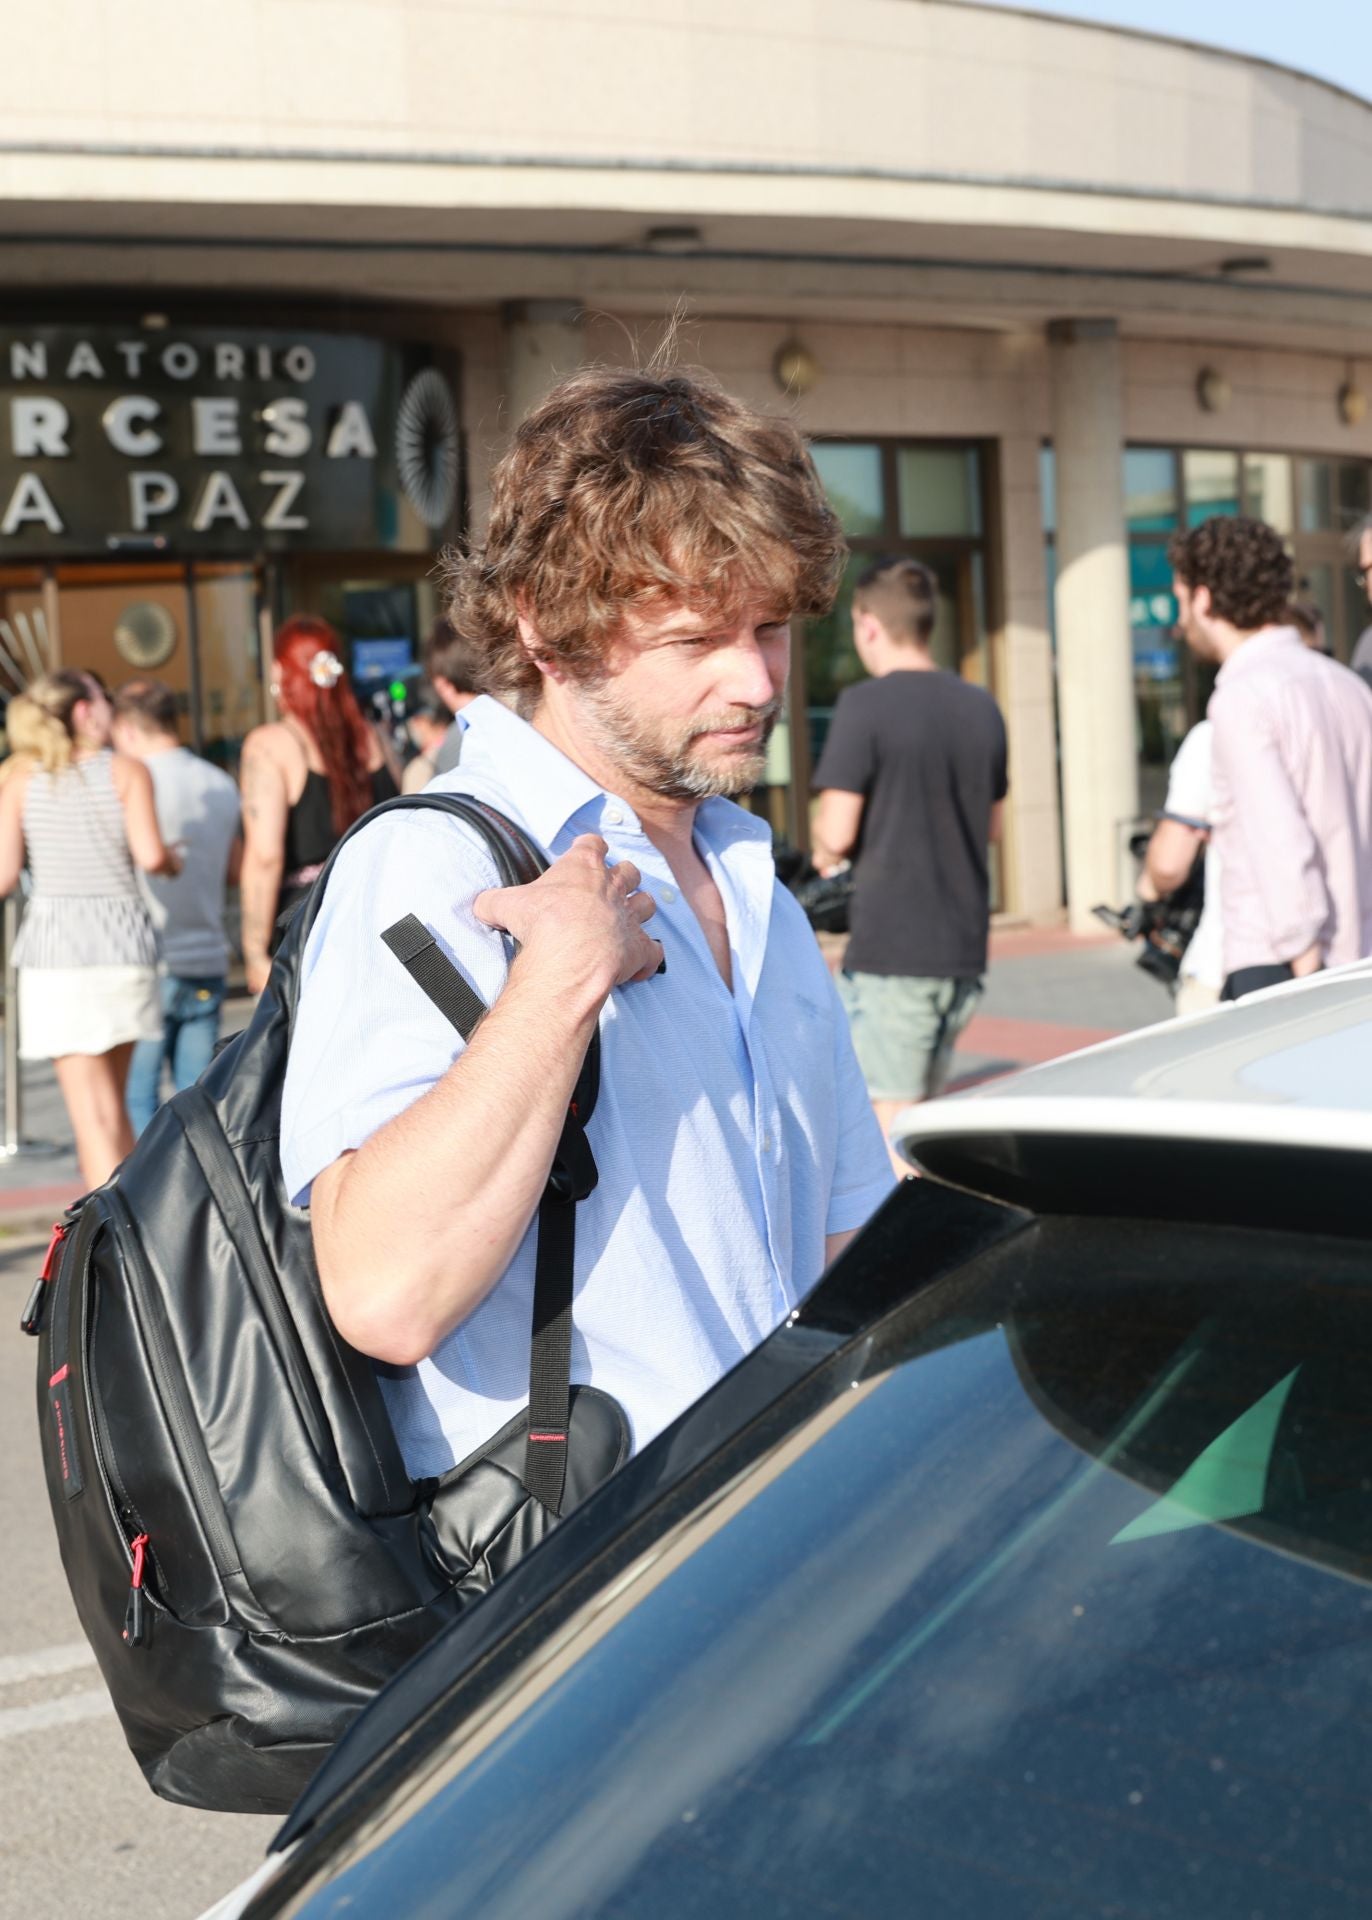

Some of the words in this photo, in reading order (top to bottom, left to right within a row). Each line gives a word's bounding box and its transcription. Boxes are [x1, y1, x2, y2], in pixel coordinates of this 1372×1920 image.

[10, 341, 316, 382] NATORIO
[11, 395, 377, 457] RCESA
[129, 471, 308, 531] PAZ
